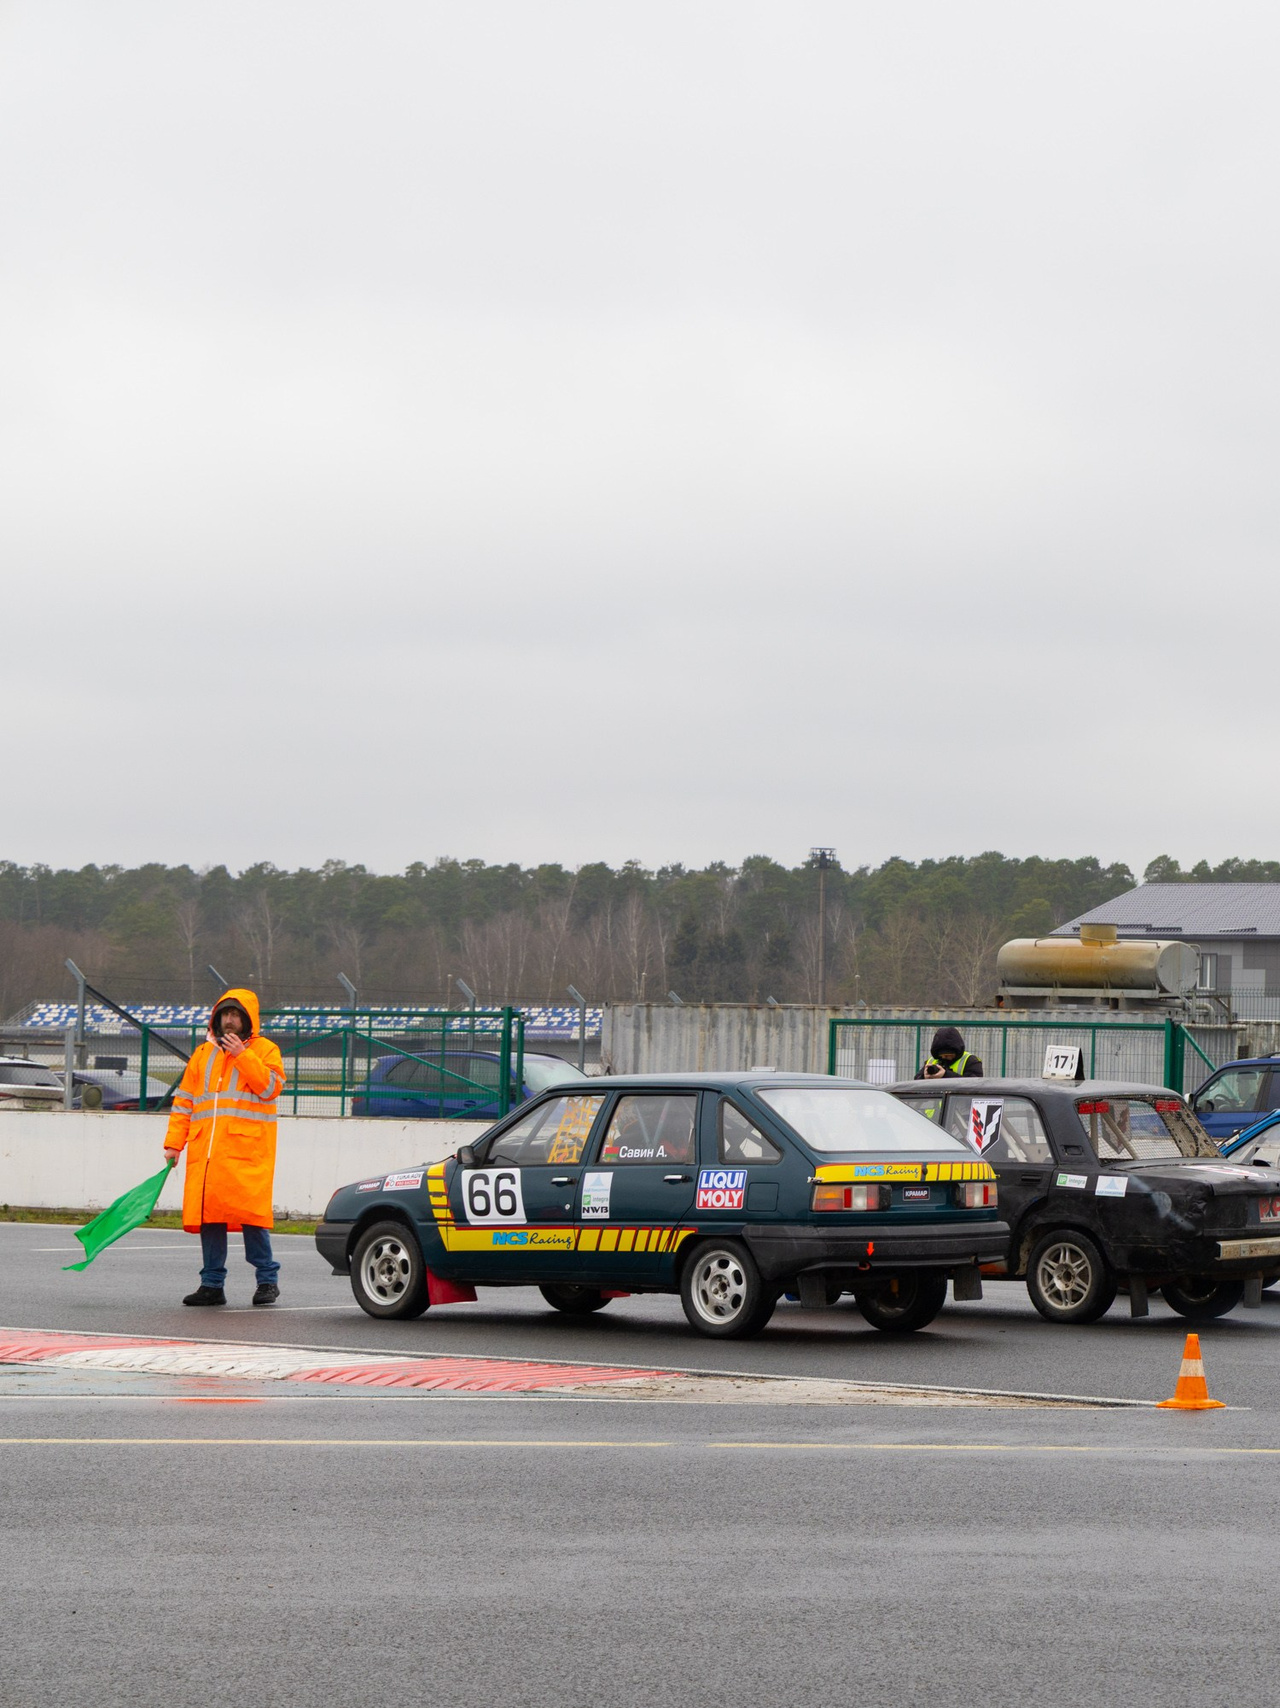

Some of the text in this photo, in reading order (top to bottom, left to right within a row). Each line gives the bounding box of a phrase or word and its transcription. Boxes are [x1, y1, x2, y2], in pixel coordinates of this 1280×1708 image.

[1054, 1054, 1069, 1069] 17
[619, 1145, 667, 1158] Савин А.
[854, 1165, 919, 1178] NCS Racing
[700, 1171, 745, 1190] LIQUI
[468, 1172, 517, 1217] 66
[699, 1190, 743, 1207] MOLY
[582, 1206, 609, 1214] NWB
[492, 1232, 573, 1249] NCS Racing
